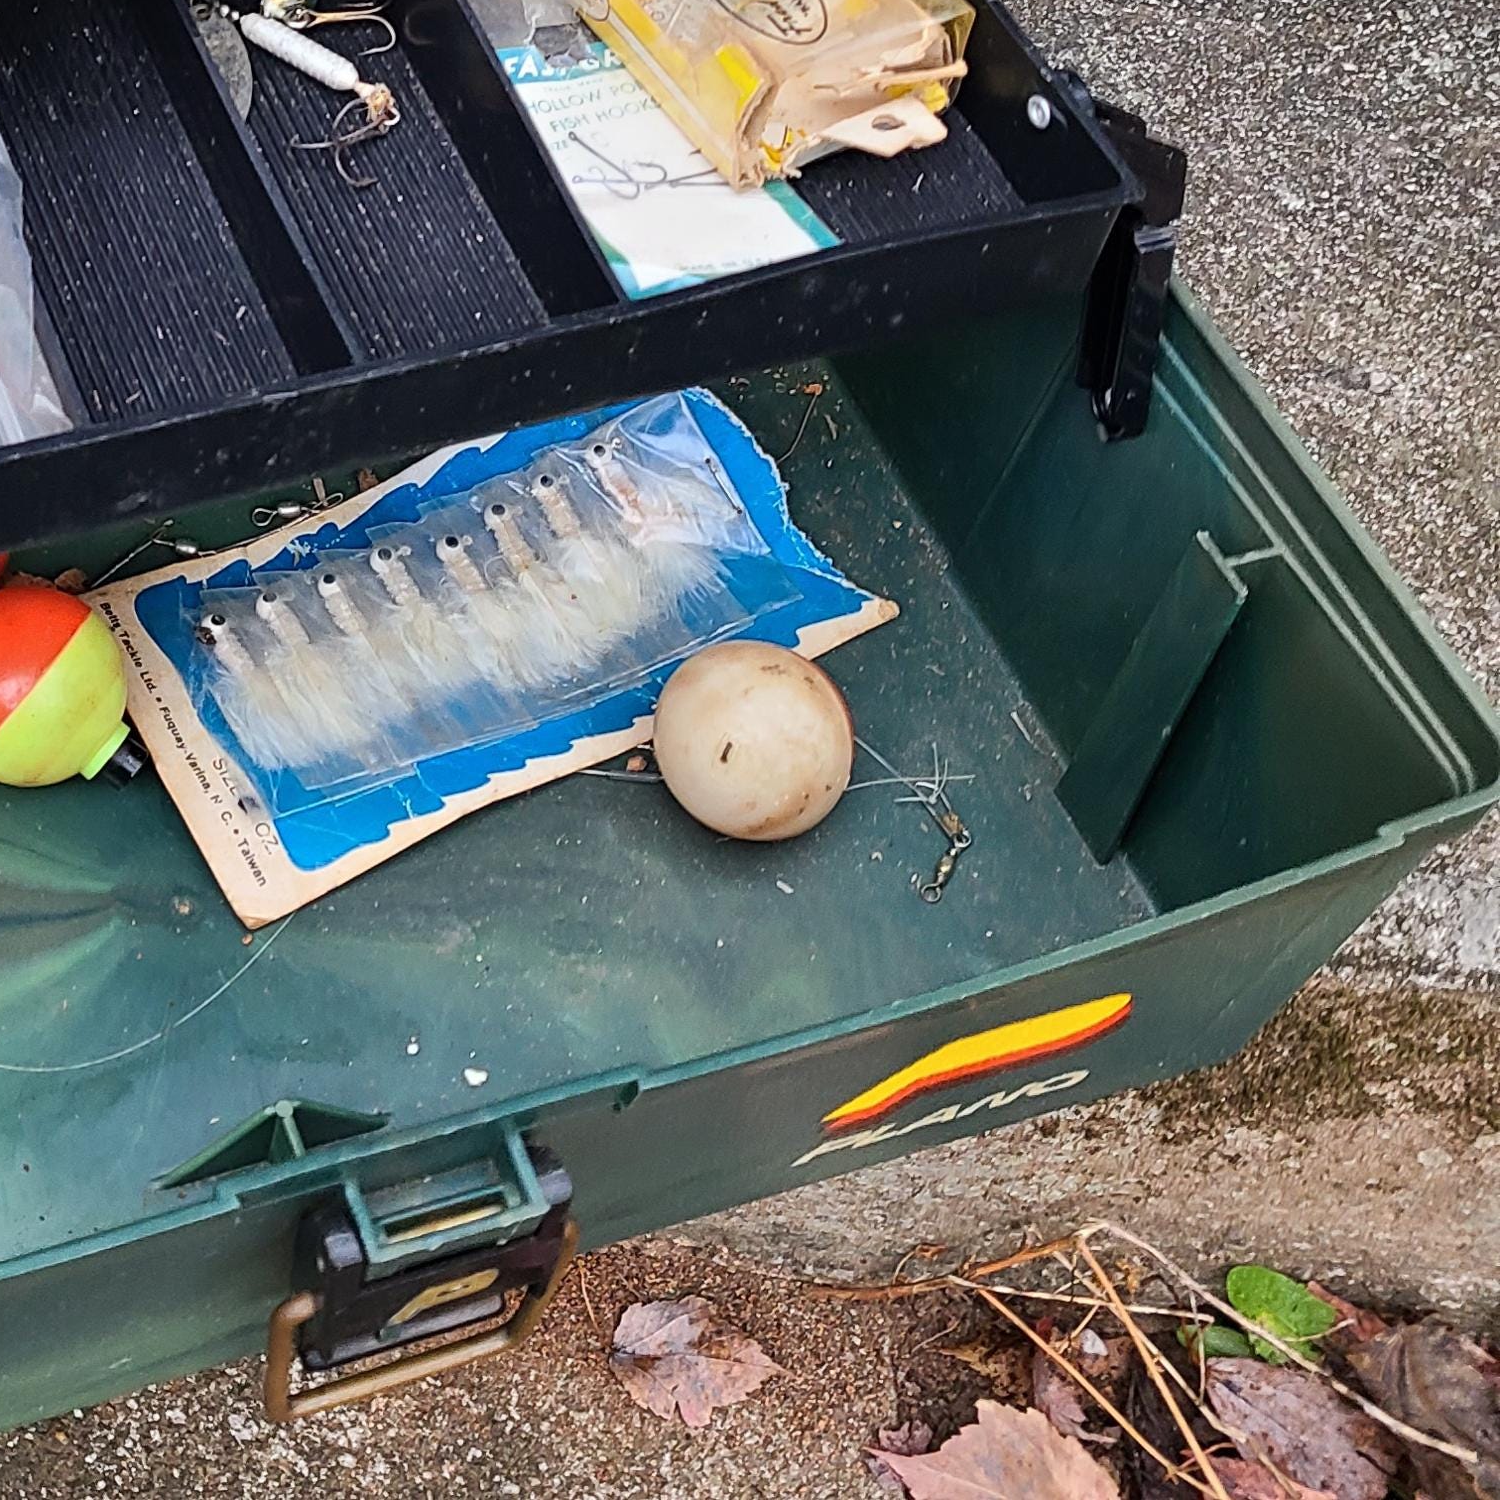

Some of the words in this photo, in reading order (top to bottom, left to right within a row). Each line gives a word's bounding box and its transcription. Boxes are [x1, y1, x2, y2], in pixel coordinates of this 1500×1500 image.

[527, 89, 601, 115] HOLLOW
[549, 113, 591, 133] FISH
[118, 630, 144, 669] Tackle
[139, 670, 157, 694] Ltd.
[159, 705, 214, 795] Fuquay-Varina,
[236, 838, 269, 887] Taiwan
[790, 1069, 1090, 1167] PLANO
